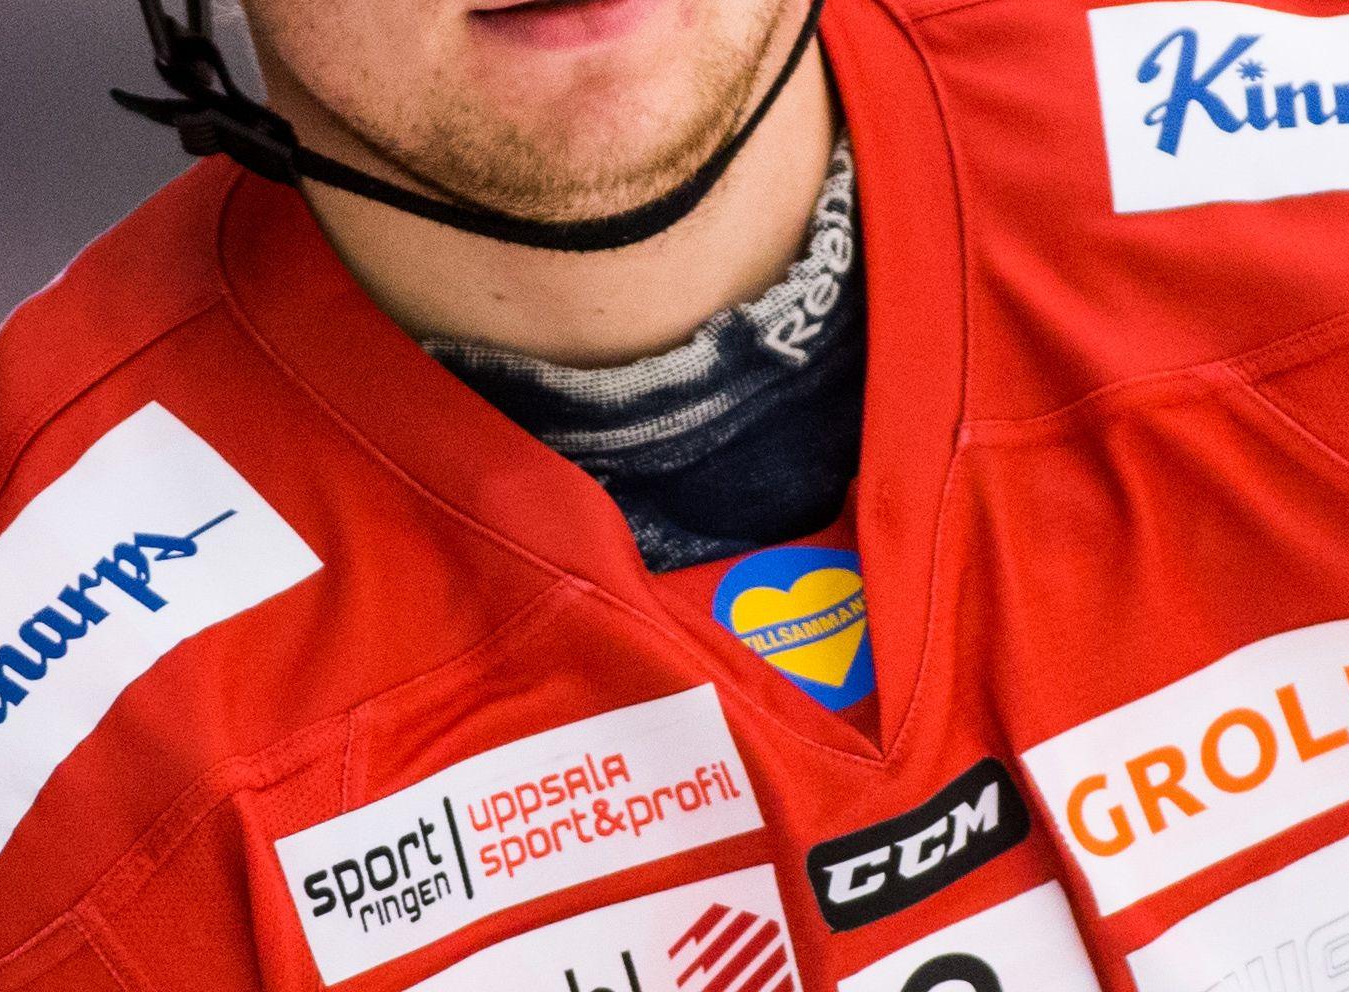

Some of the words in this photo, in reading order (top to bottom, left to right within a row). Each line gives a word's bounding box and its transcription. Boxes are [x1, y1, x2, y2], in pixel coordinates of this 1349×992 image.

[467, 753, 631, 833] uppsala
[479, 760, 741, 879] sport&profil
[822, 781, 999, 904] CCM
[303, 817, 443, 919] sport
[359, 871, 452, 933] ringen
